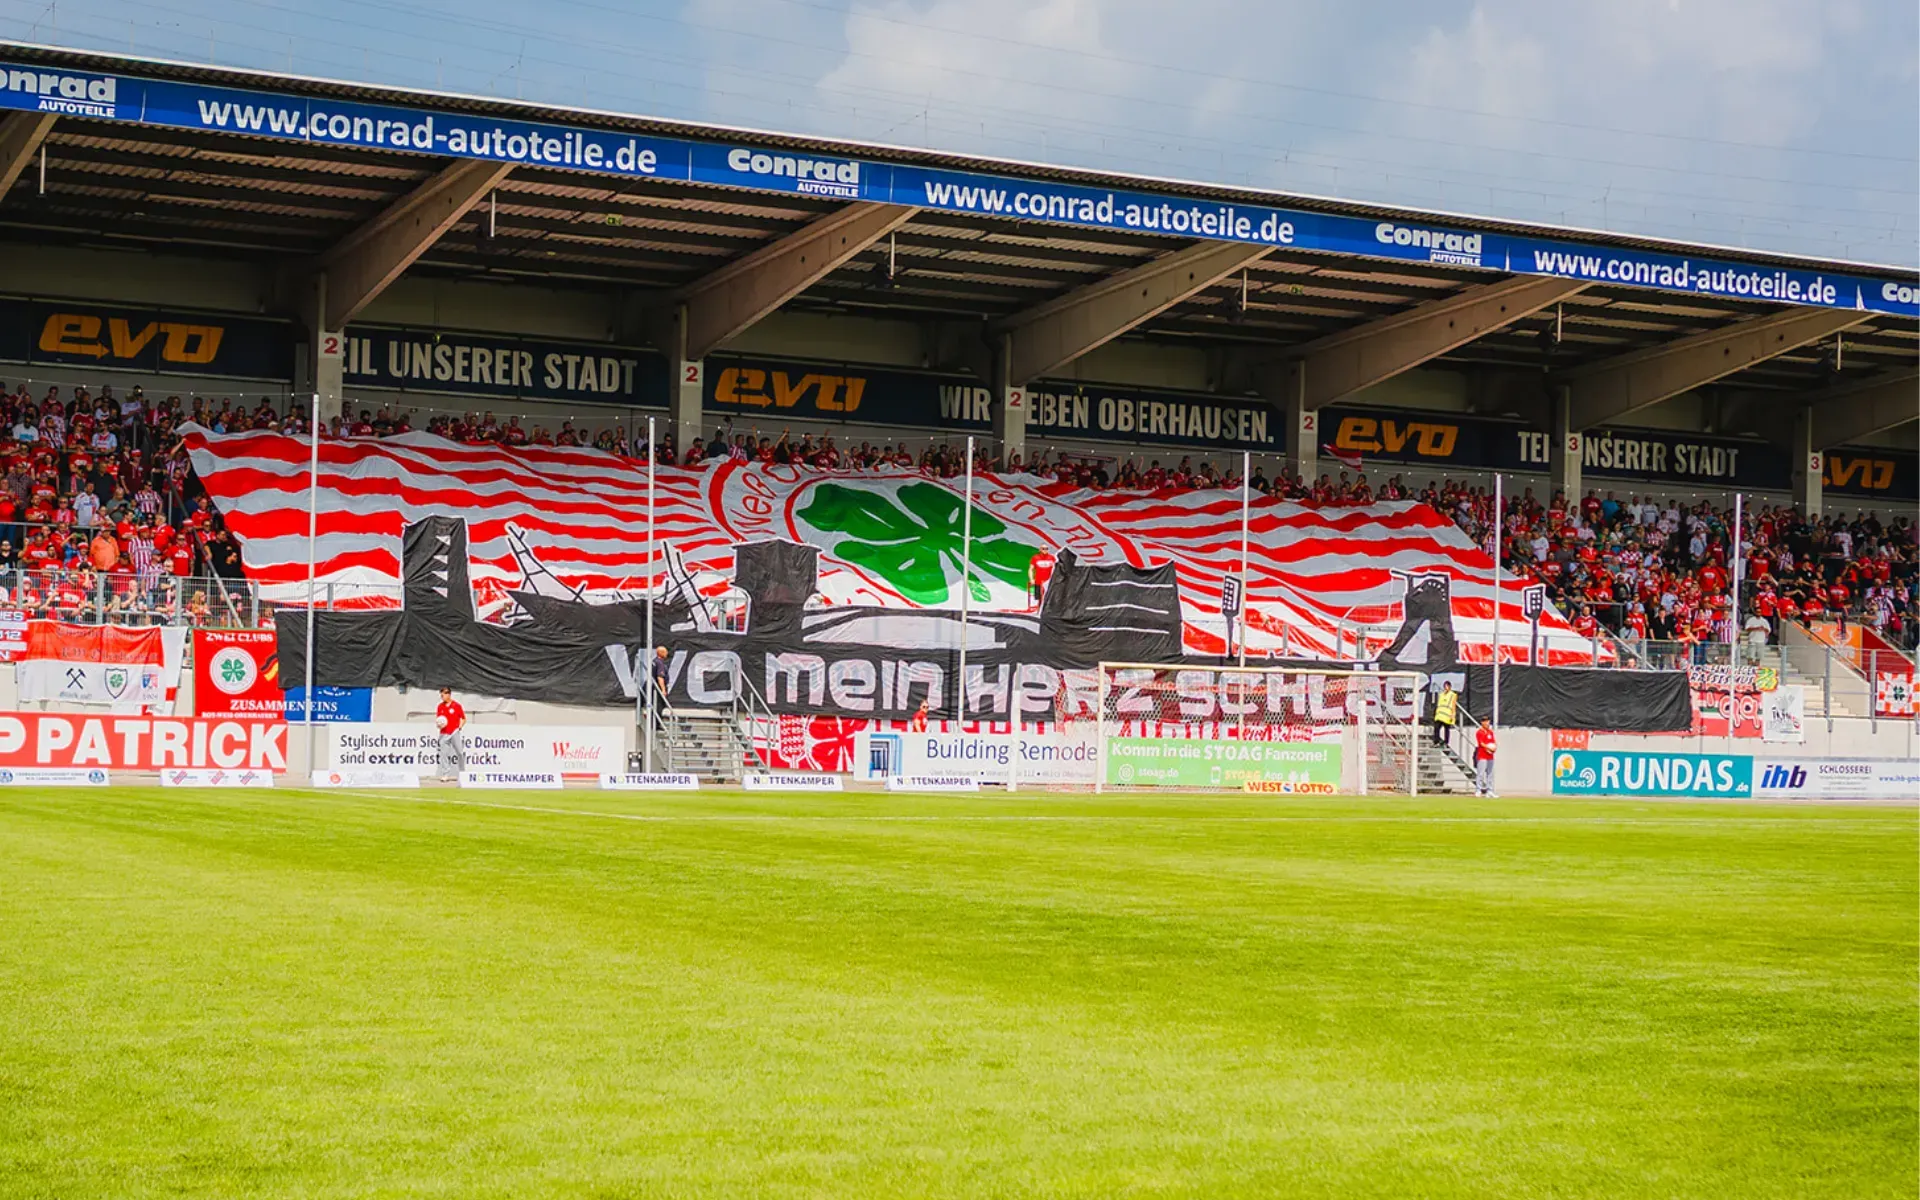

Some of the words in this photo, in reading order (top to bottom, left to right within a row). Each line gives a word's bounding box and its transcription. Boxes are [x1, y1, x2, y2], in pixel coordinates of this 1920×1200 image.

[0, 68, 116, 102] nrad
[38, 100, 115, 118] AUTOTEILE
[198, 100, 657, 173] www.conrad-autoteile.de
[727, 149, 860, 184] Conrad
[796, 181, 859, 198] AUTOTEILE
[924, 181, 1294, 243] www.conrad-autoteile.de
[1375, 222, 1482, 254] Conrad
[1431, 252, 1481, 266] AUTOTEILE
[1534, 250, 1836, 304] www.conrad-autoteile.de
[38, 313, 224, 363] evo
[323, 337, 339, 355] 2
[388, 340, 533, 387] UNSERER
[543, 353, 638, 395] STADT
[685, 366, 698, 382] 2
[714, 367, 867, 412] evo
[1010, 391, 1021, 407] 2
[939, 384, 992, 422] WIR
[1025, 391, 1089, 429] EBEN
[1099, 397, 1274, 444] OBERHAUSEN.
[1303, 415, 1314, 430] 2
[1335, 416, 1459, 456] evo
[1568, 436, 1578, 451] 3
[1517, 431, 1549, 463] TEI
[1580, 433, 1667, 472] NSERER
[1674, 443, 1739, 478] STADT
[1811, 456, 1819, 470] 3
[1822, 456, 1896, 489] vo
[238, 633, 274, 643] CLUBS
[230, 699, 305, 711] ZUSAMMEN
[310, 701, 338, 712] EINS
[36, 717, 287, 769] PATRICK
[340, 734, 389, 751] Stylisch
[391, 738, 417, 749] zum
[462, 735, 472, 749] ie
[474, 735, 524, 749] Daumen
[552, 741, 602, 760] Westfield
[927, 738, 1009, 764] Building
[1112, 742, 1160, 757] Komm
[1163, 743, 1177, 757] in
[1178, 744, 1200, 758] die
[1203, 744, 1263, 761] STOAG
[1265, 747, 1328, 762] Fanzone!
[340, 751, 365, 765] sind
[368, 753, 414, 765] extra
[1138, 767, 1180, 779] stoag.de
[1225, 770, 1261, 780] STOAG
[1264, 770, 1283, 782] App
[1600, 756, 1734, 792] RUNDAS
[1760, 765, 1808, 789] ihb
[1819, 764, 1872, 774] SCHLOSSEREI
[1247, 782, 1282, 793] WEST
[1294, 782, 1333, 794] LOTTO
